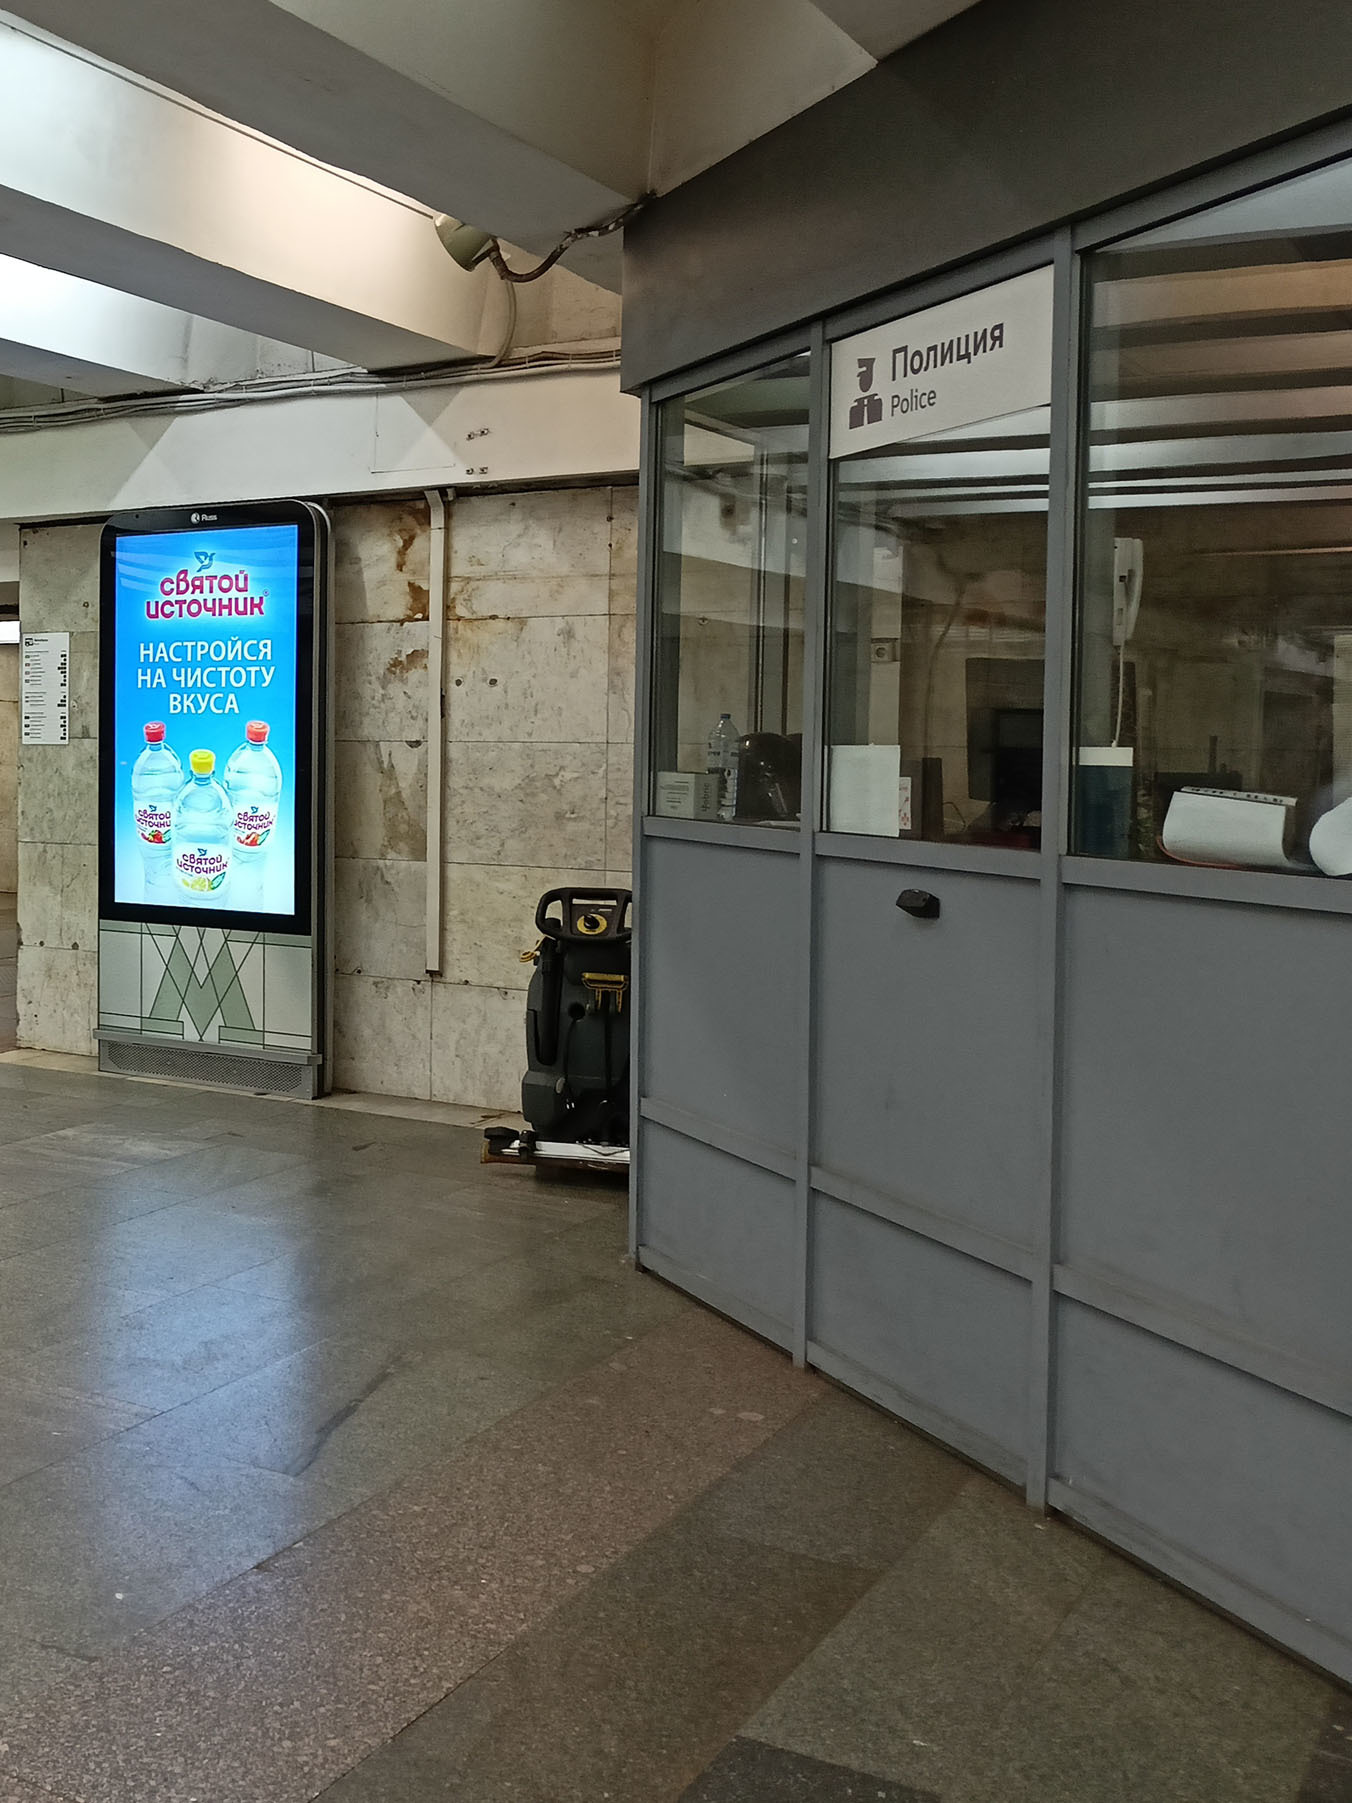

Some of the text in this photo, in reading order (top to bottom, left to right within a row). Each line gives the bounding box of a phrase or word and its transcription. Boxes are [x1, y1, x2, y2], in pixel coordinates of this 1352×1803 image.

[891, 322, 1004, 382] Полиция
[890, 388, 937, 417] Police
[139, 636, 272, 663] НАСТРОЙСЯ
[137, 666, 275, 688] НА ЧИСТОТУ
[169, 693, 239, 714] ВКУСА
